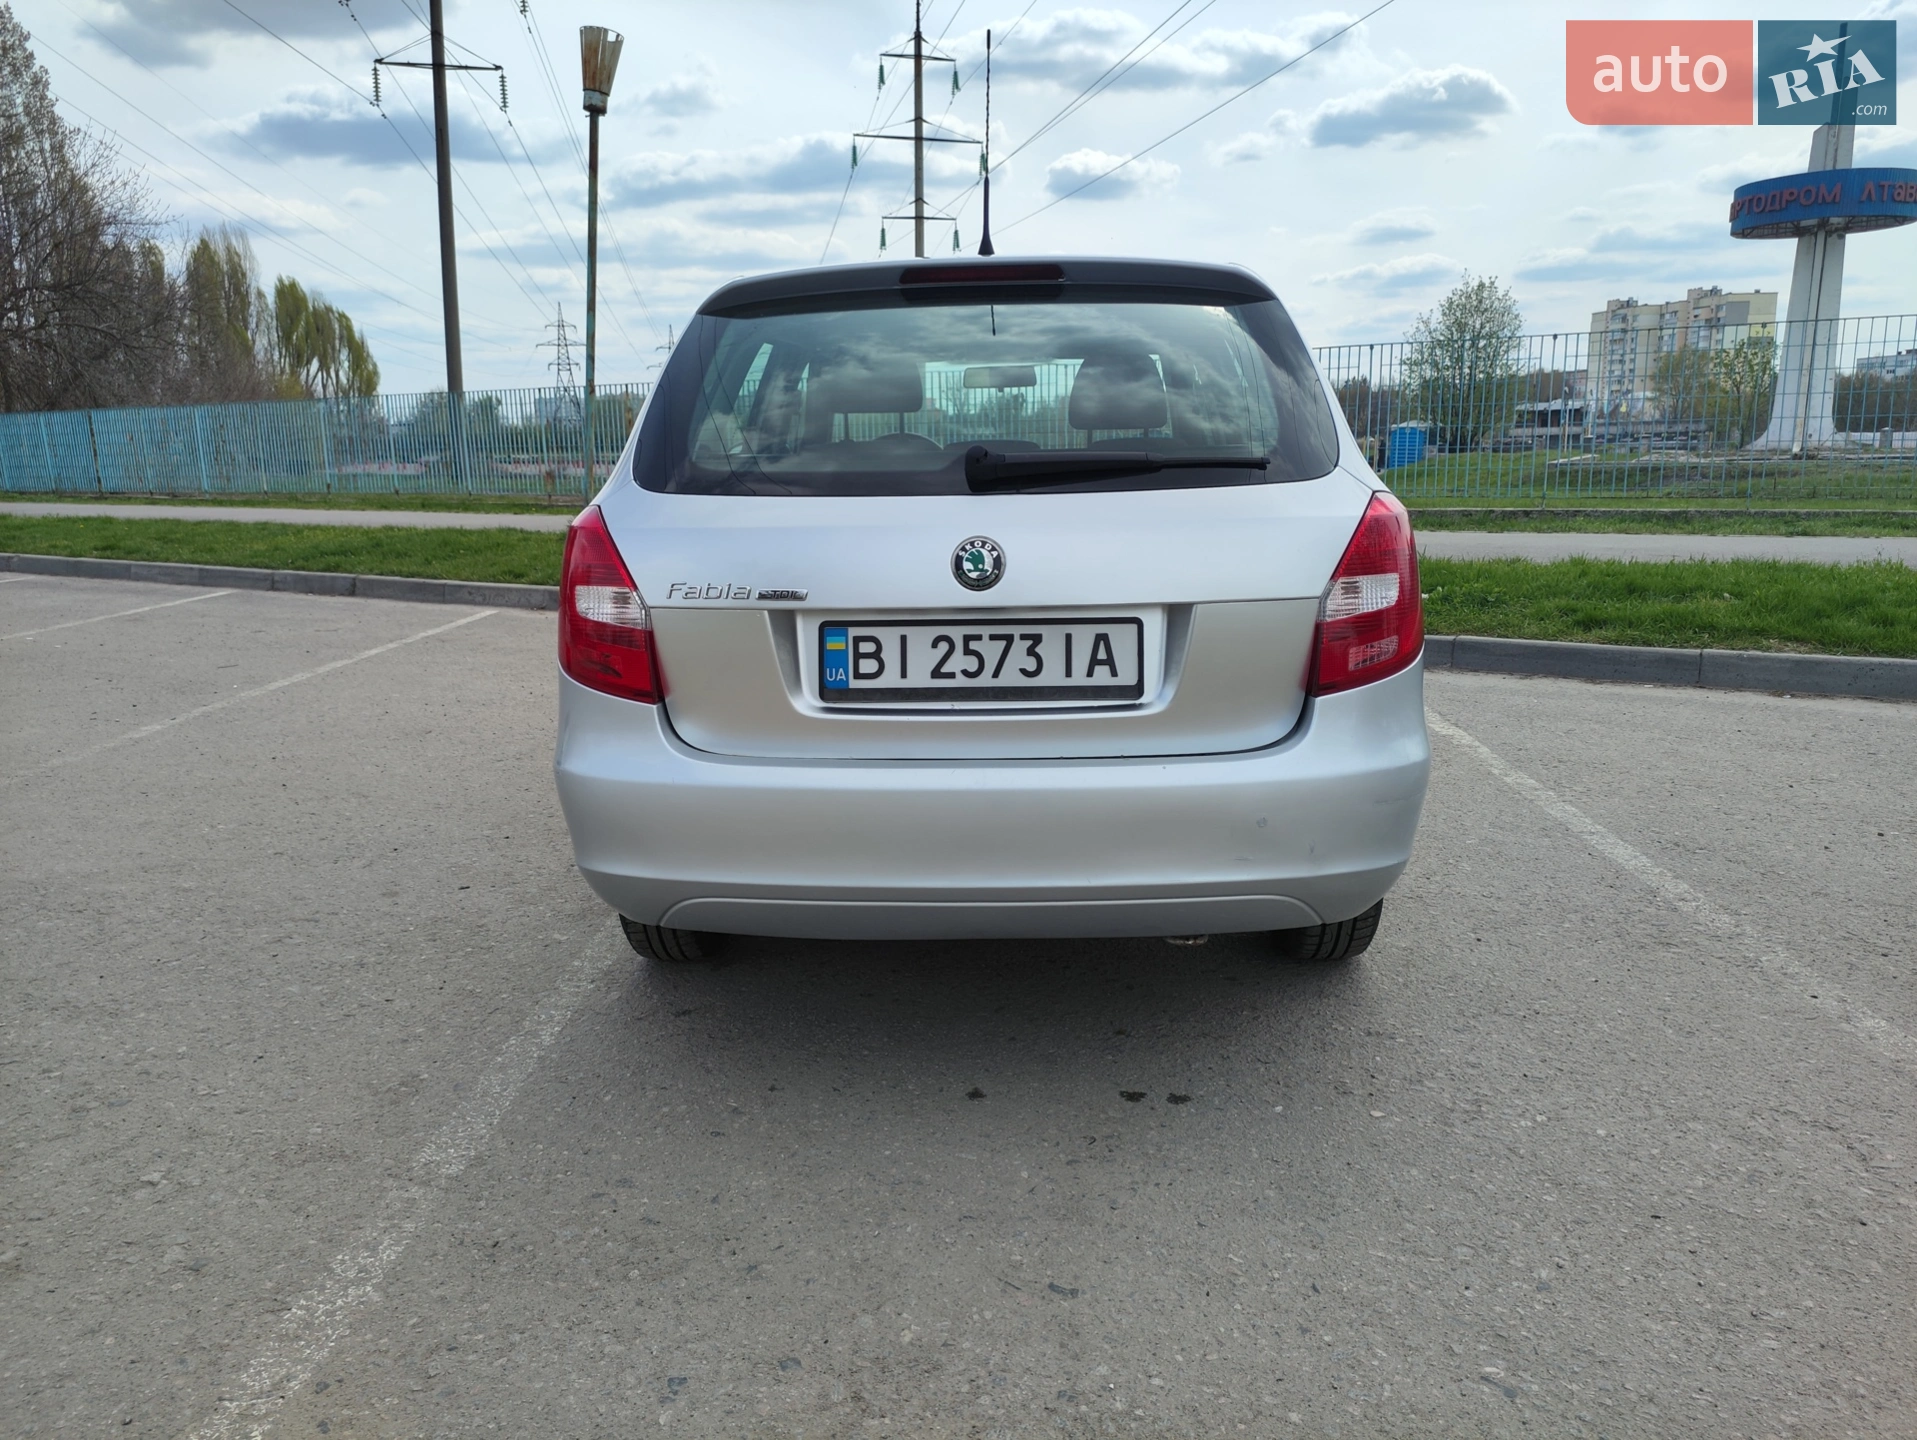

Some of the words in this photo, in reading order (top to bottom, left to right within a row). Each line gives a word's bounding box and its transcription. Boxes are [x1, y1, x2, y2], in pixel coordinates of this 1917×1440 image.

[666, 581, 752, 600] Fabia
[852, 634, 908, 680] BI
[930, 633, 1044, 679] 2573
[1065, 632, 1119, 678] IA
[826, 667, 847, 682] UA
